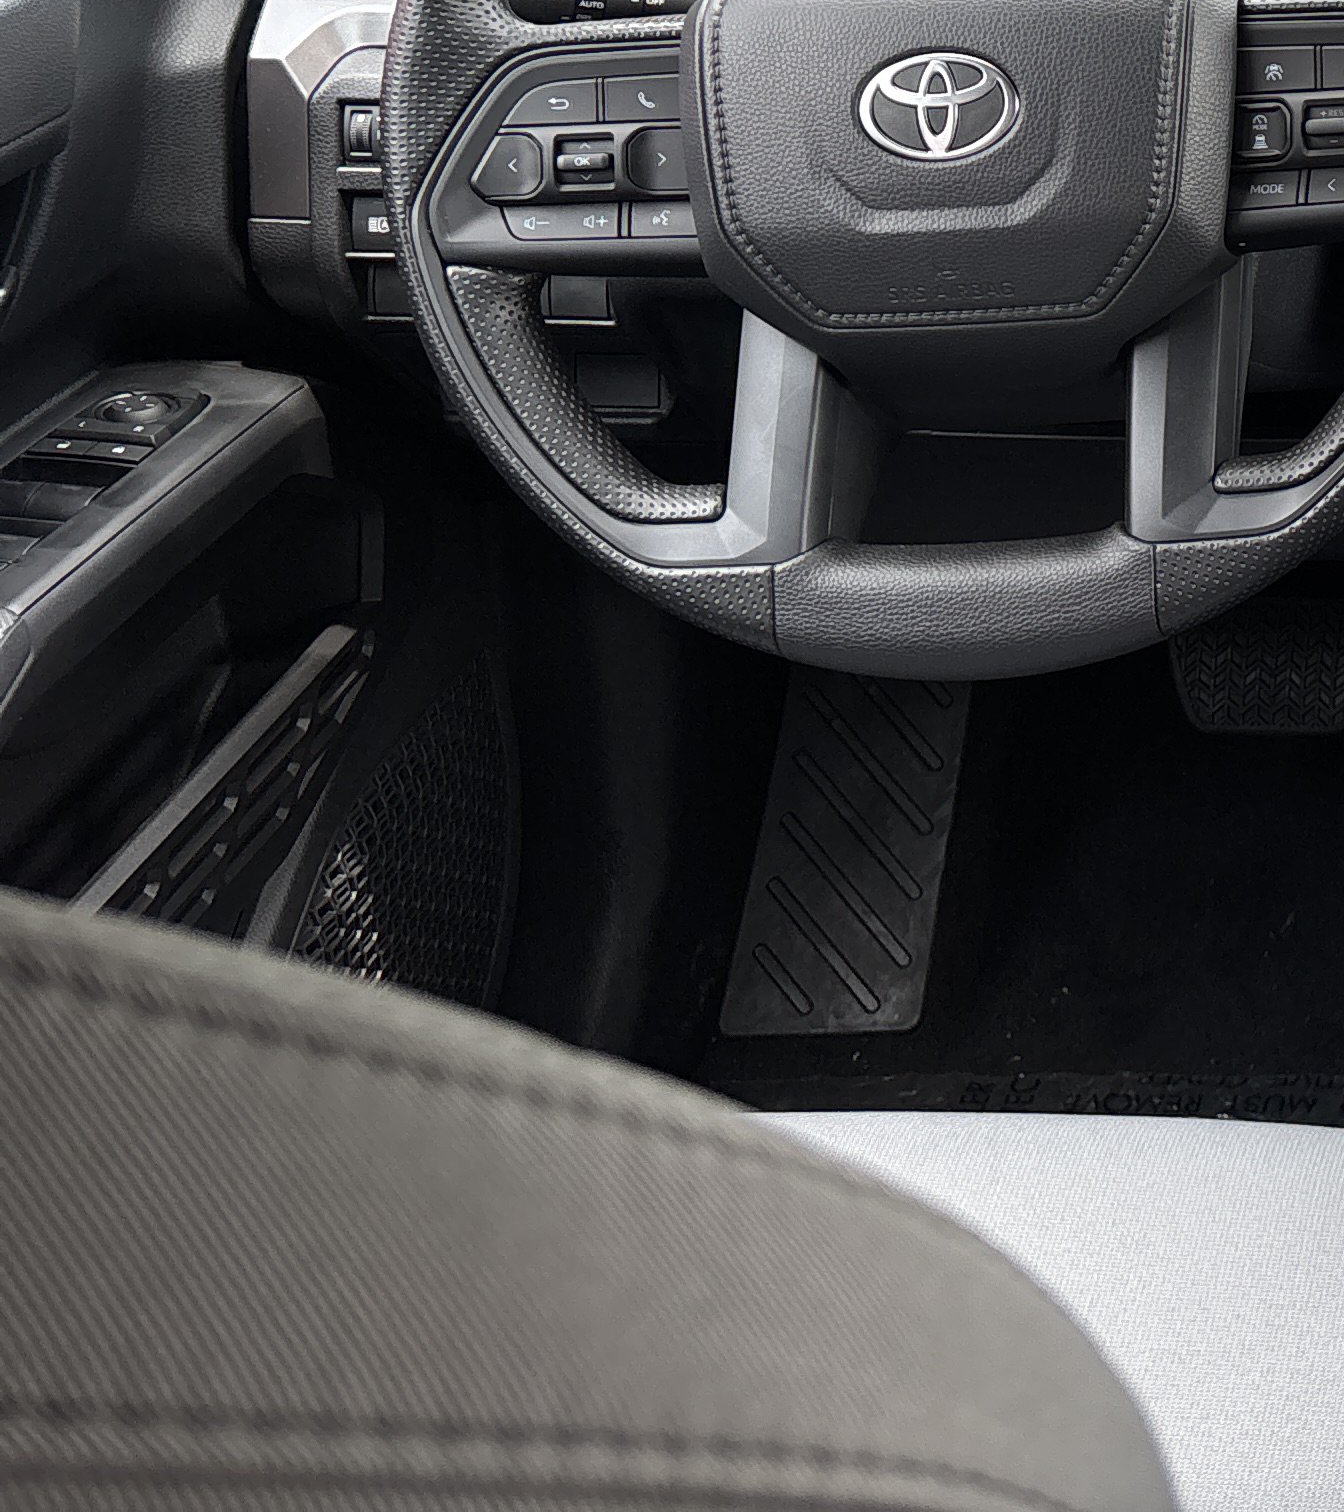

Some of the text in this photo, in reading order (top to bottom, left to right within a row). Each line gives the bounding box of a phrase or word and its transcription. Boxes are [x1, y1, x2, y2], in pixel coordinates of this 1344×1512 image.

[578, 0, 605, 10] AUTO
[573, 156, 591, 167] OK
[1250, 183, 1285, 195] MODE
